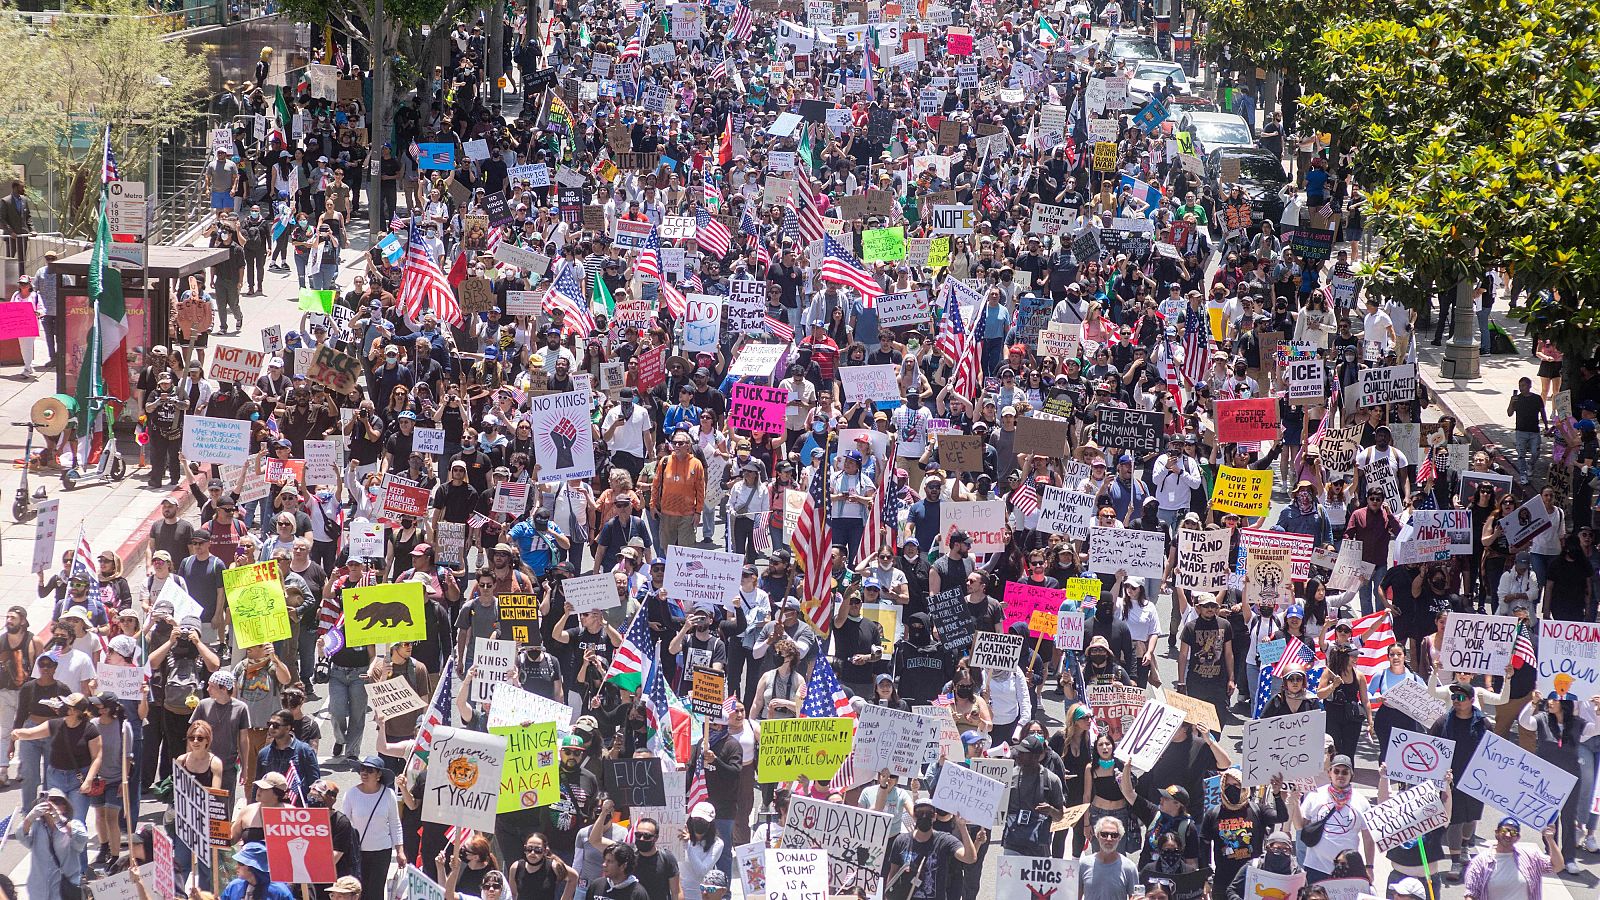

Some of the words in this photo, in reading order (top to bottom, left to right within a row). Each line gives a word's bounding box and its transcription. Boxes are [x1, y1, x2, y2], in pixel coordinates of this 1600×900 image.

[487, 200, 504, 208] KINGS
[491, 205, 504, 213] JUST
[934, 210, 973, 229] NOPE
[465, 279, 483, 290] GOD
[731, 281, 767, 293] ELECT
[464, 289, 489, 303] BLESS
[878, 294, 908, 303] DIGNITY
[687, 301, 719, 323] NO
[895, 304, 917, 312] RAZA
[879, 314, 912, 323] ESTAMOS
[1056, 333, 1077, 341] THOSE
[216, 347, 242, 362] NOT
[245, 352, 266, 367] MY
[1046, 346, 1070, 356] VOICE
[211, 364, 260, 385] CHEETOH!
[1291, 364, 1321, 380] ICE:
[1364, 371, 1383, 382] MEN
[1383, 370, 1392, 380] OF
[1363, 383, 1392, 396] QUALITY
[1393, 378, 1415, 391] ACCEPT
[533, 398, 551, 411] NO
[554, 393, 587, 408] KINGS
[735, 386, 764, 401] FUCK
[764, 390, 788, 405] ICE
[1375, 392, 1415, 404] EQUALITY
[734, 404, 766, 420] FUCK
[1102, 410, 1120, 423] THE
[1123, 412, 1153, 427] REAL
[1235, 416, 1264, 424] PEOPLE
[1100, 423, 1142, 438] CRIMINAL
[1145, 428, 1156, 439] IS
[1352, 423, 1365, 437] LET
[939, 439, 967, 451] FUCK
[1102, 436, 1112, 446] IN
[1115, 437, 1160, 453] OFFICE!
[1323, 440, 1343, 451] THE
[1320, 450, 1354, 462] GRIND
[1220, 472, 1247, 482] PROUD
[388, 487, 405, 496] KEEP
[1228, 483, 1246, 491] LIVE
[388, 493, 415, 505] FAMILIES
[1044, 487, 1094, 508] IMMIGRANTS
[1227, 490, 1248, 499] CITY
[1252, 492, 1263, 500] OF
[385, 500, 419, 512] TOGETHER!
[1213, 497, 1263, 510] IMMIGRANTS
[972, 505, 992, 519] Are
[1040, 509, 1083, 525] AMERICA
[1433, 511, 1472, 528] SASHAY
[1182, 530, 1206, 541] THIS
[1192, 540, 1223, 552] LAND
[1179, 552, 1204, 563] WAS
[1179, 561, 1208, 573] MADE
[1210, 562, 1226, 574] FOR
[673, 578, 704, 589] constitution
[1179, 573, 1199, 587] YOU
[1212, 575, 1226, 586] ME
[499, 595, 510, 606] ICE
[512, 595, 527, 606] OUT
[528, 595, 537, 606] OF
[686, 590, 724, 602] TYRANNY!
[935, 589, 954, 603] THERE
[501, 608, 515, 619] OUR
[516, 608, 538, 620] HOME
[238, 613, 288, 643] MELT
[1454, 620, 1517, 643] REMEMBER
[1543, 623, 1562, 638] NO
[978, 632, 1023, 646] AMERICANS
[1057, 635, 1081, 650] MIGRA
[1465, 640, 1485, 651] YOUR
[486, 641, 499, 651] NO
[975, 641, 1018, 656] AGAINST
[477, 656, 508, 667] KINGS
[906, 658, 942, 670] MEXICO
[975, 653, 1018, 669] TYRANNY
[1450, 650, 1491, 670] OATH
[489, 671, 507, 682] THE
[1540, 659, 1598, 683] CLOWN
[695, 685, 721, 695] Fascist
[697, 679, 720, 689] Trump
[1092, 686, 1114, 694] MAIN
[1116, 686, 1143, 694] EVENT
[371, 689, 412, 709] DICKTATOR
[694, 691, 721, 702] Regime
[382, 701, 413, 717] ENERGY
[864, 704, 880, 716] CITY
[889, 709, 914, 723] DREAMS
[763, 722, 778, 734] ALL
[781, 722, 788, 733] OF
[790, 721, 799, 734] MY
[801, 720, 835, 734] OUTRAGE
[859, 722, 880, 730] CHINGA
[781, 735, 791, 745] FIT
[802, 734, 817, 745] ONE
[819, 732, 838, 744] SIGN
[434, 732, 498, 767] Tangerine
[761, 746, 773, 756] PUT
[775, 746, 796, 755] DOWN
[796, 745, 810, 754] THE
[1392, 733, 1408, 747] NO
[1430, 738, 1453, 759] KINGS
[1482, 735, 1516, 768] Kings
[1518, 753, 1541, 778] have
[509, 756, 534, 774] TU
[974, 760, 1008, 777] Trump
[613, 762, 657, 787] FUCK
[947, 767, 972, 782] GRAB
[1386, 770, 1404, 781] LAND
[500, 772, 551, 794] MAGA
[175, 767, 207, 813] POWER
[969, 785, 987, 798] THE
[432, 785, 497, 813] TYRANT
[937, 789, 994, 816] CATHETER
[1464, 768, 1509, 808] Since
[1508, 791, 1555, 829] 1776
[281, 810, 311, 823] NO
[790, 801, 892, 846] SOLIDARITY
[265, 824, 329, 837] KINGS
[177, 824, 209, 865] PEOPLE
[822, 833, 851, 849] HAS
[776, 853, 818, 863] DONALD
[779, 865, 815, 875] TRUMP
[1032, 860, 1051, 870] NO
[1021, 869, 1062, 884] KINGS
[409, 874, 426, 897] FIGHT
[786, 882, 797, 890] IS
